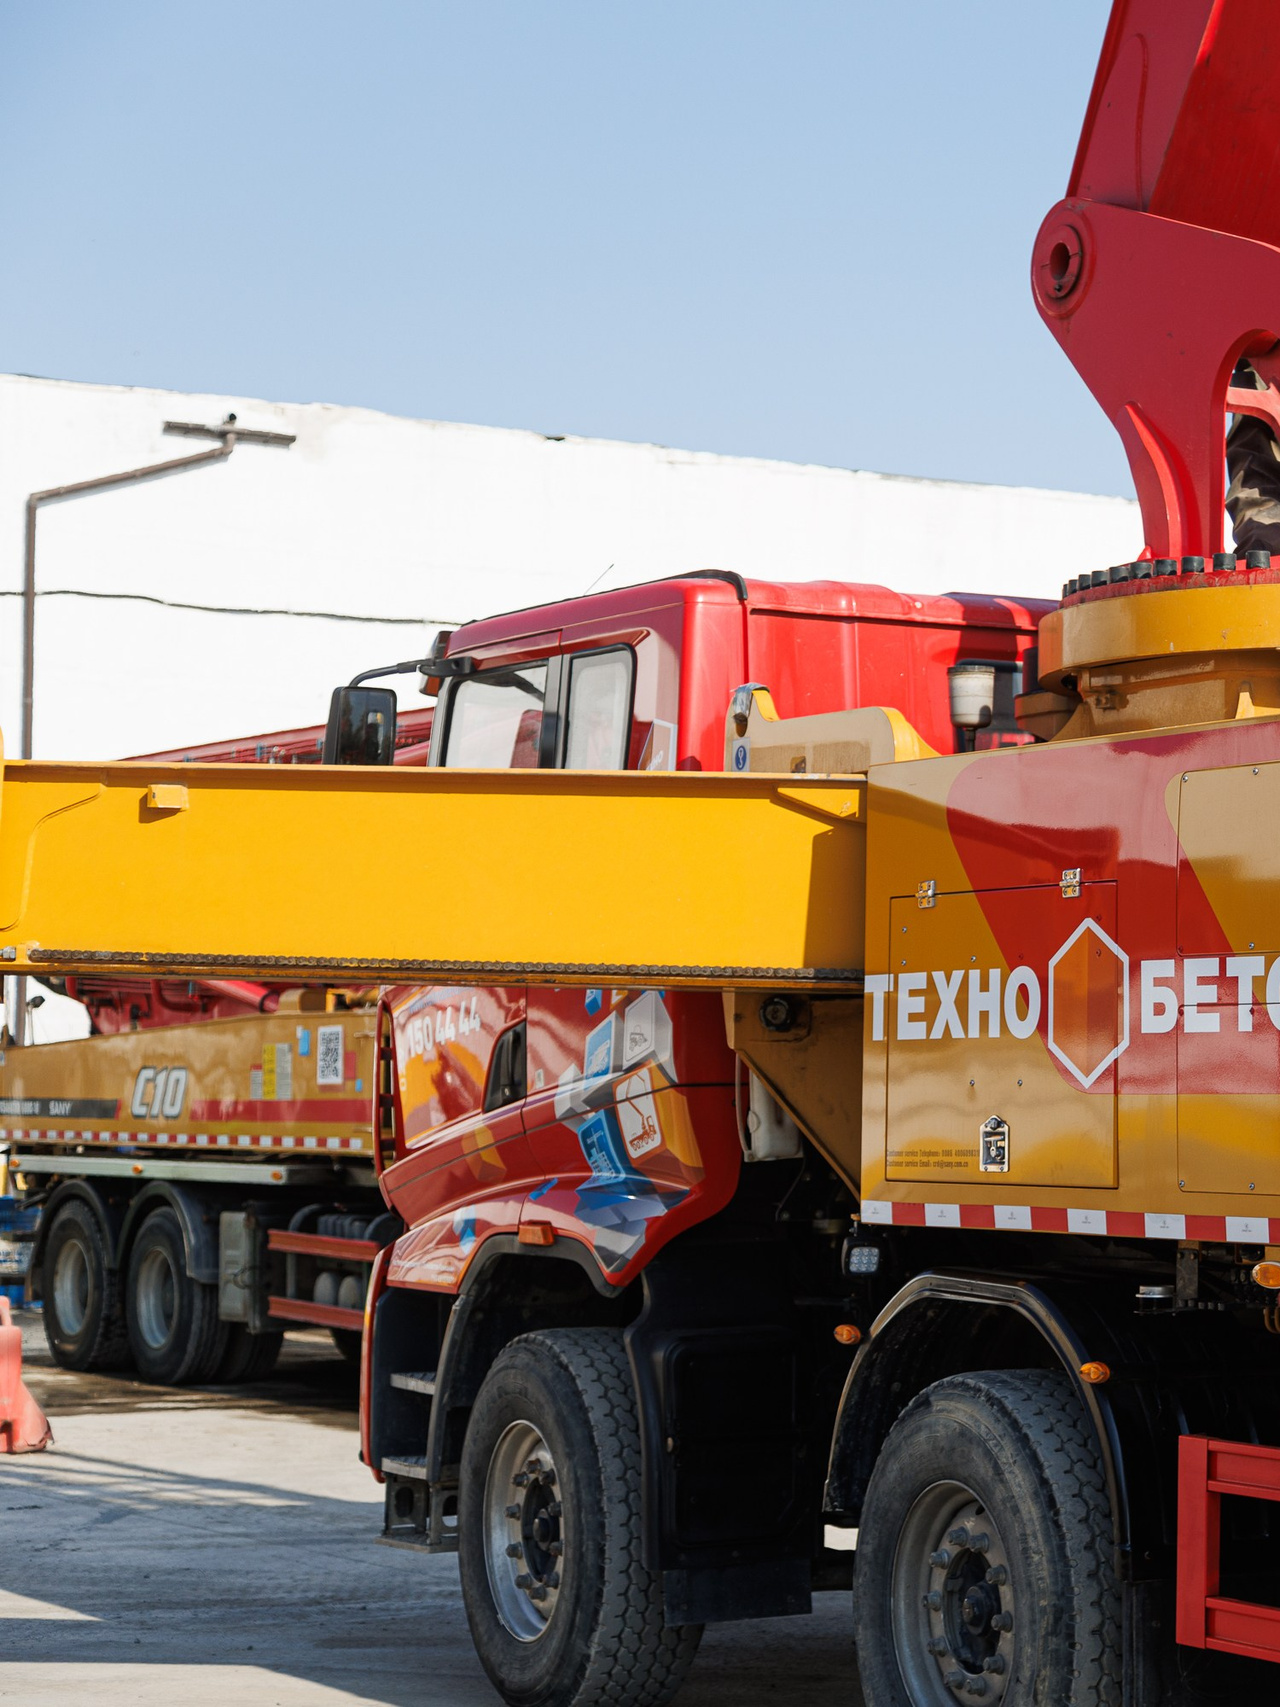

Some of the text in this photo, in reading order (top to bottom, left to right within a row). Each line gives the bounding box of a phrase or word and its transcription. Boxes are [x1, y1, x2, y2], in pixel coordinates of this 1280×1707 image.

[407, 1015, 433, 1058] 150
[435, 1006, 456, 1045] 44
[459, 996, 481, 1036] 44
[864, 966, 1041, 1041] ТЕХНО
[49, 1100, 73, 1116] SANY
[131, 1066, 188, 1119] C10
